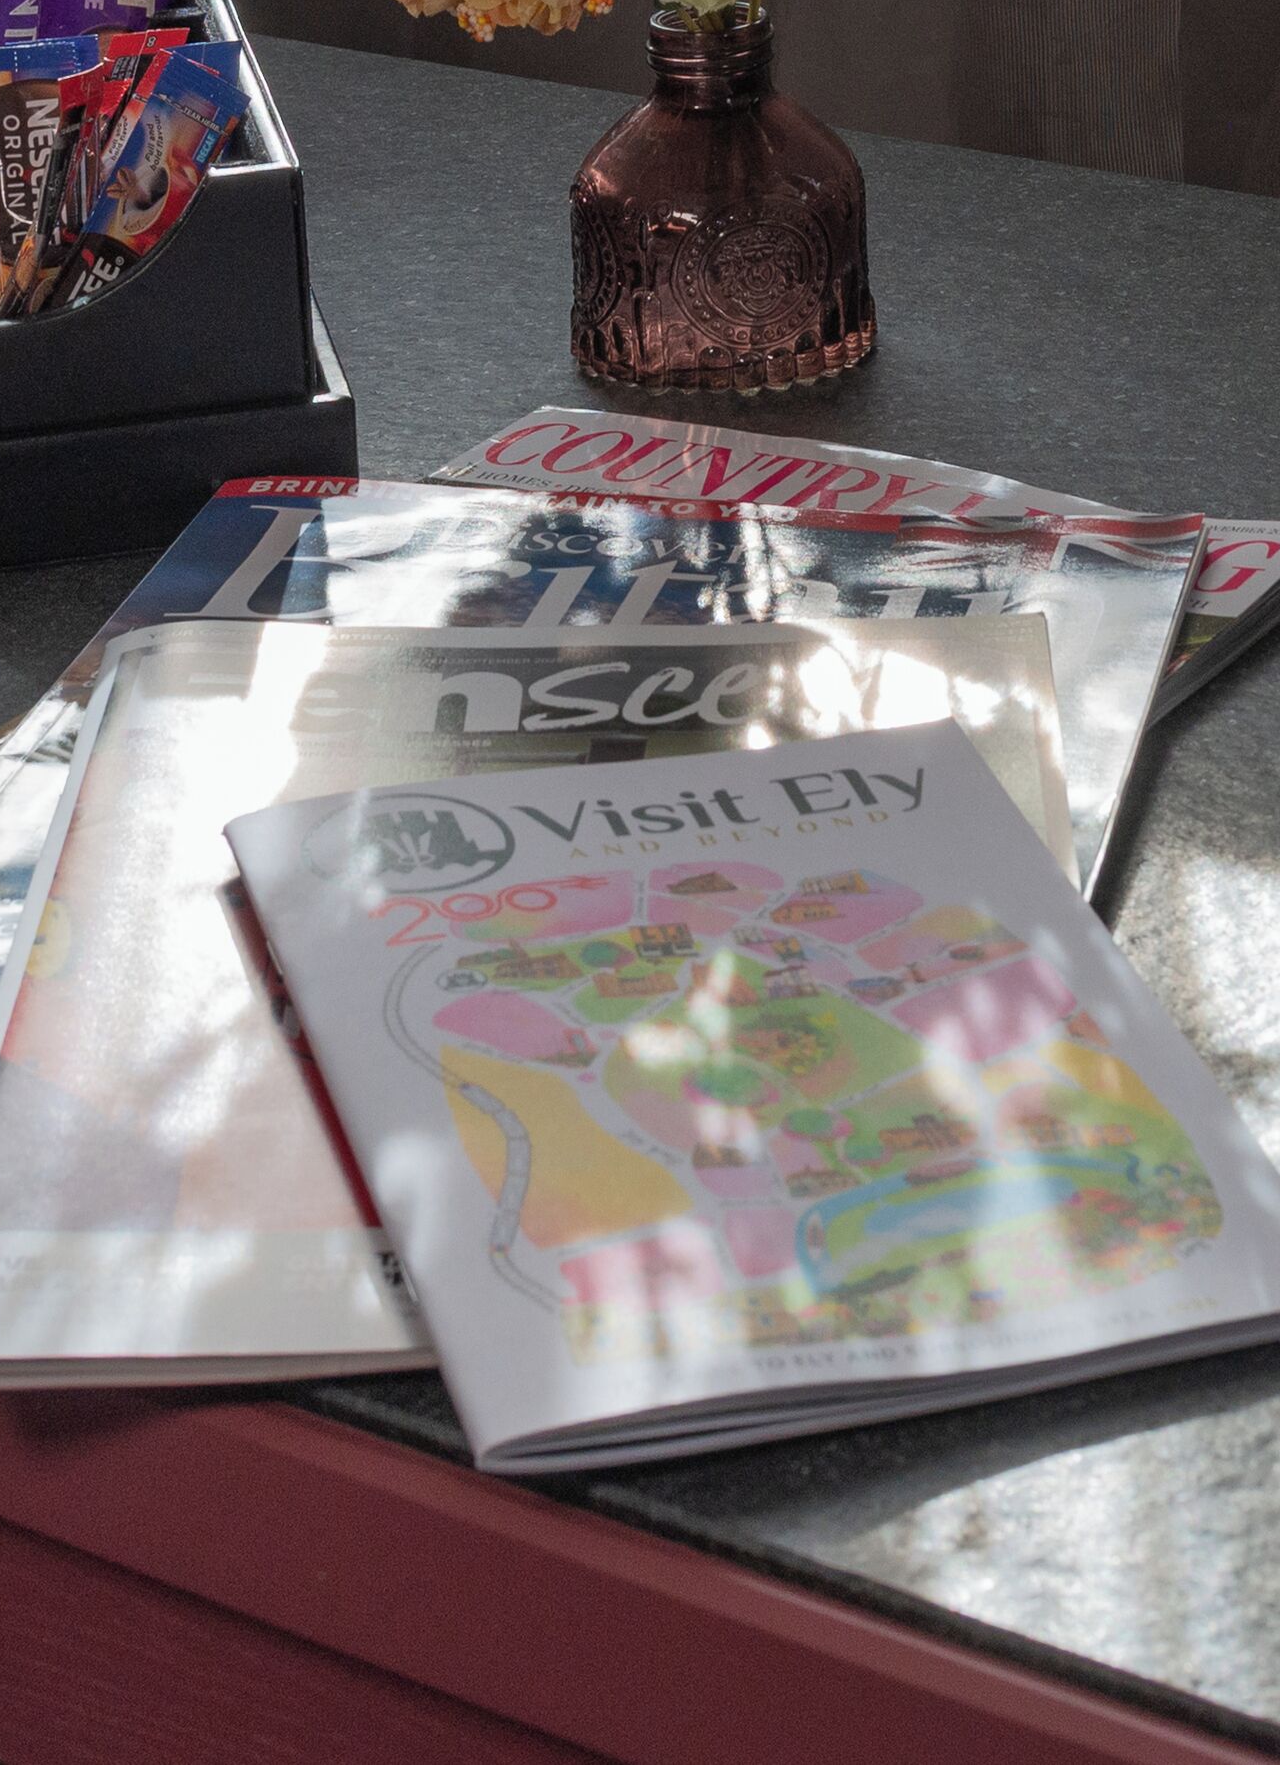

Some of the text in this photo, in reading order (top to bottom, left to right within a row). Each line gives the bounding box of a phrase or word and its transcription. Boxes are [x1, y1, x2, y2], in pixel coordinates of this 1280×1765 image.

[3, 114, 29, 245] ORIGINAL
[475, 470, 552, 490] HOMES
[484, 421, 941, 514] COUNTRY
[648, 497, 697, 515] TO
[716, 502, 802, 523] YOU
[514, 765, 927, 843] Visit Ely
[569, 809, 889, 860] AND BEYOND
